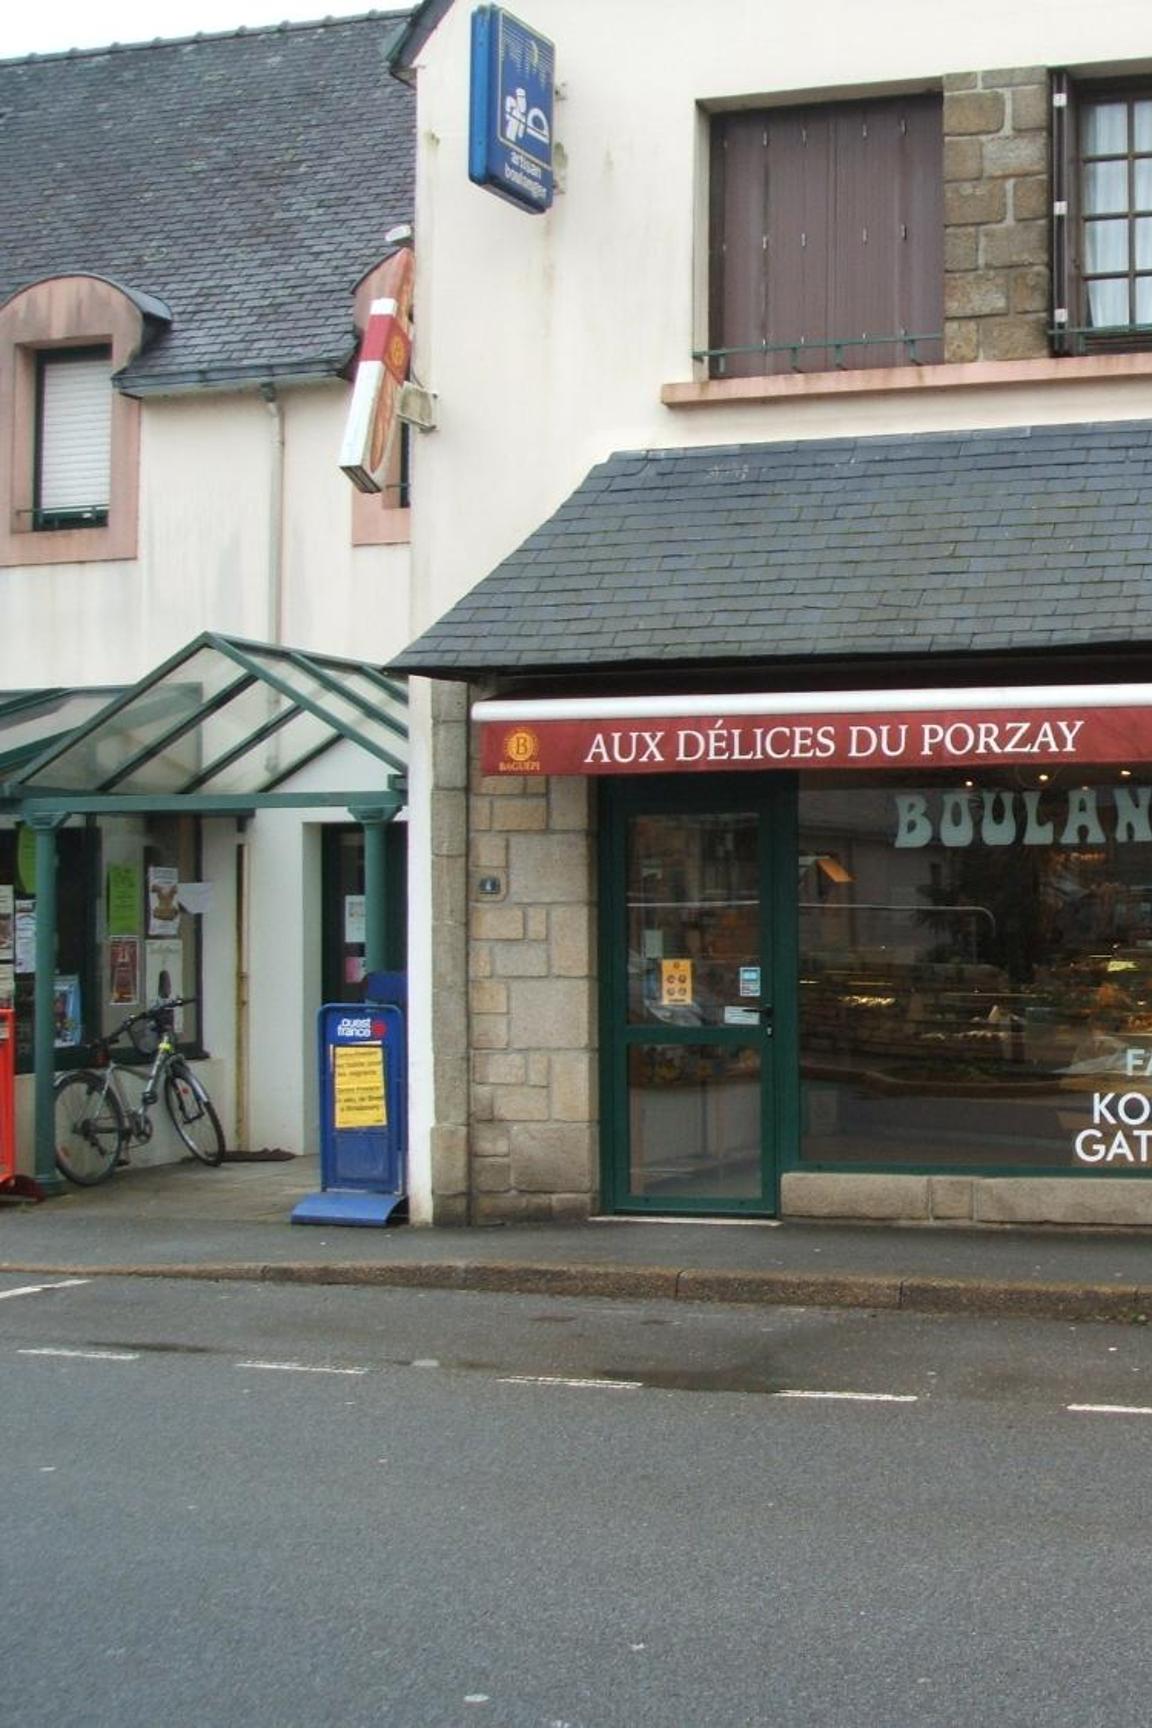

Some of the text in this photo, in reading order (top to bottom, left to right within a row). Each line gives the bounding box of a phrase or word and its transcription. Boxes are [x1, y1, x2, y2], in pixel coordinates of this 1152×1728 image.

[585, 720, 1084, 763] AUX DÉLICES DU PORZAY
